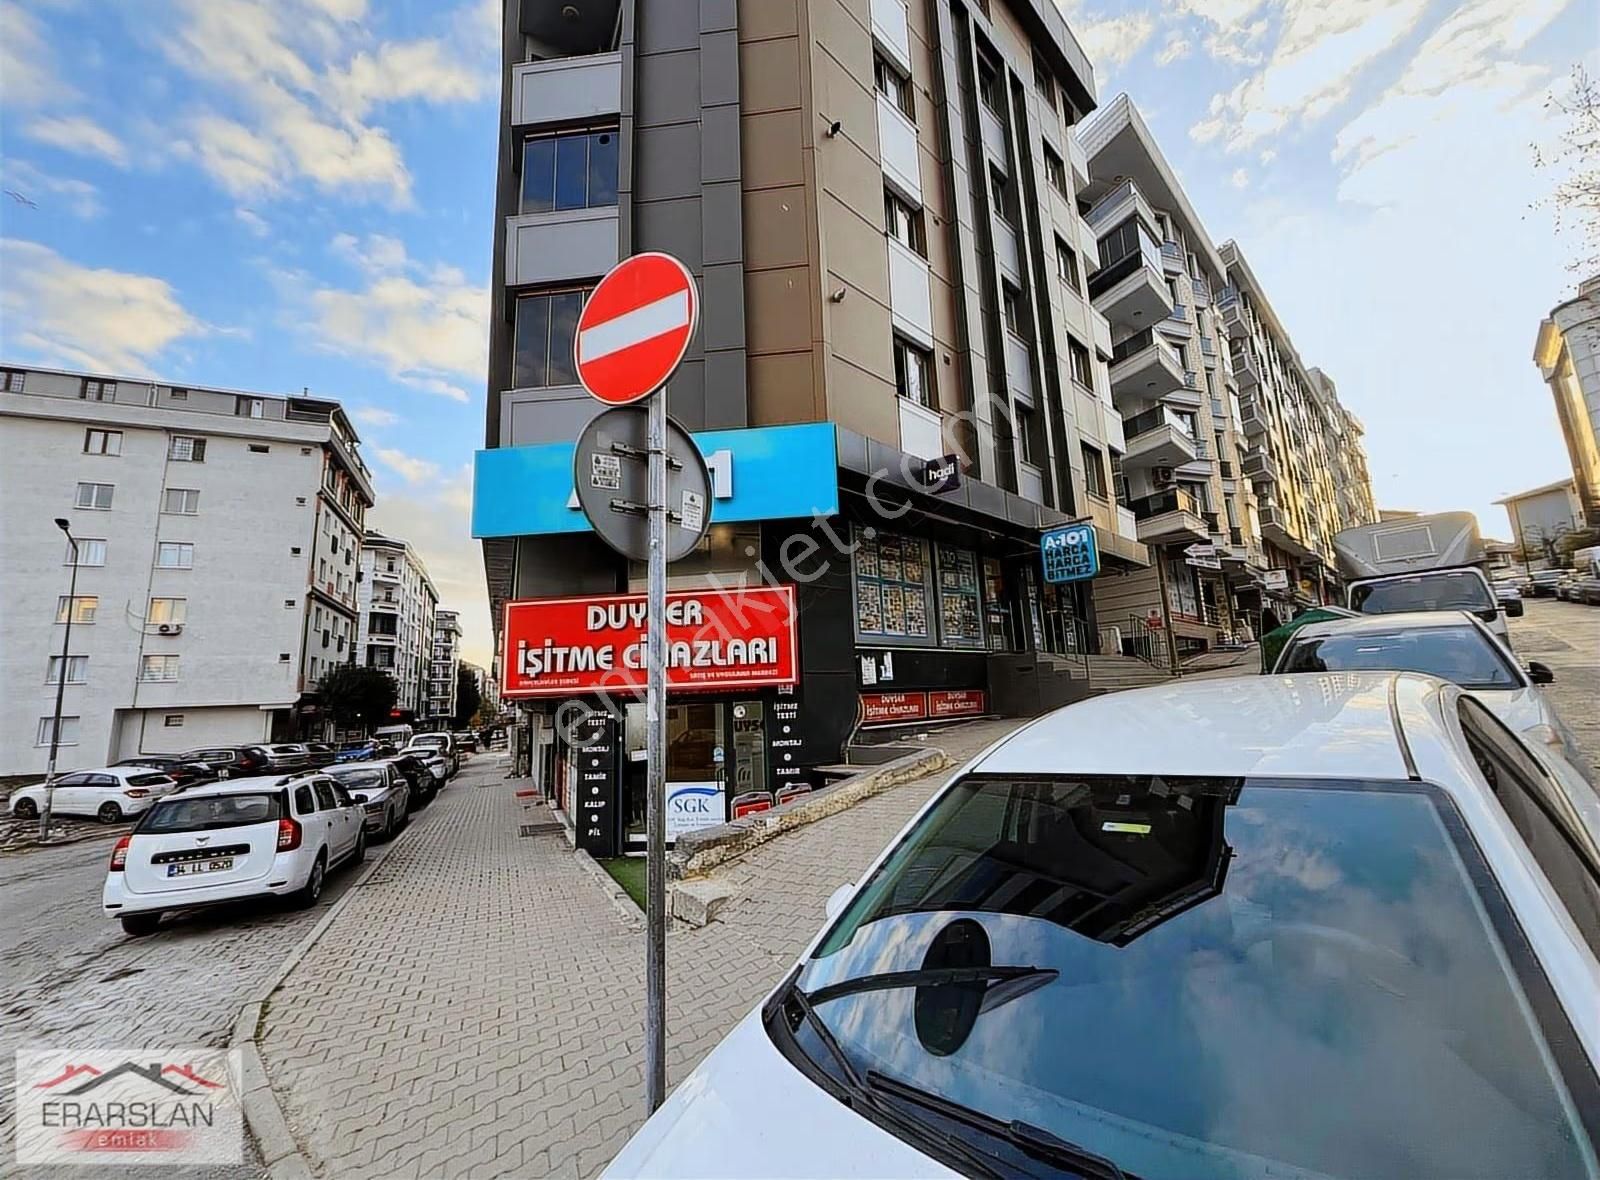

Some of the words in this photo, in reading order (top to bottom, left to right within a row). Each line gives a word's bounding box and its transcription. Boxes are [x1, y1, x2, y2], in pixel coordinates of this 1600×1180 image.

[928, 462, 955, 480] hadi
[587, 600, 703, 630] DUYER
[518, 639, 613, 678] İŞİTME
[674, 798, 709, 813] SGK
